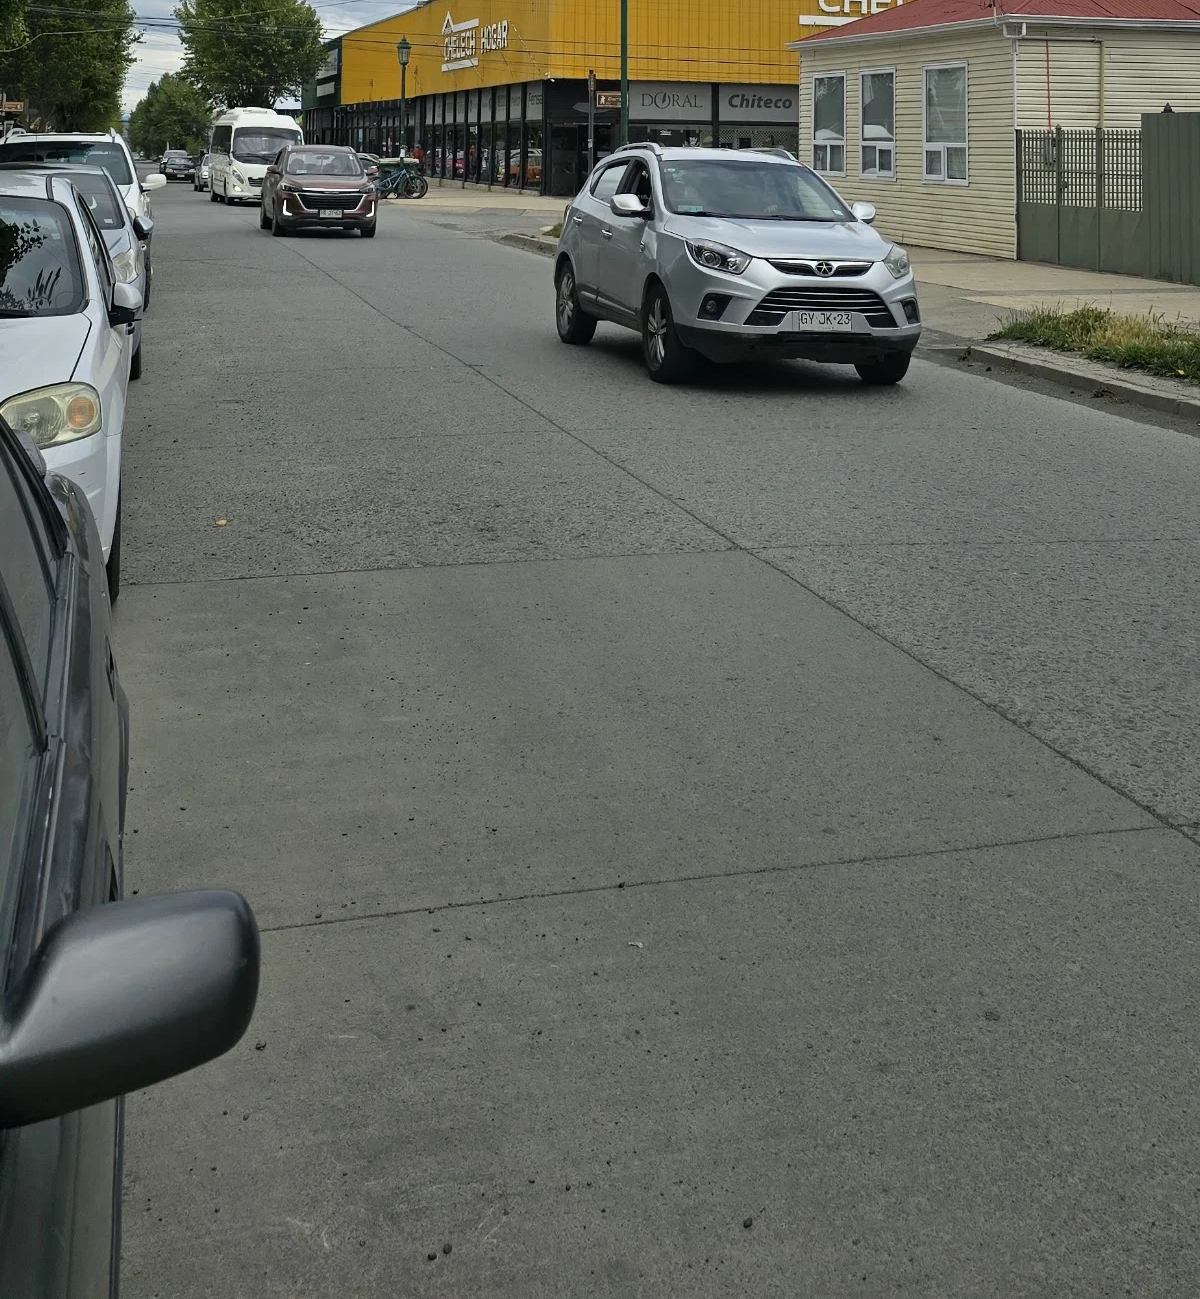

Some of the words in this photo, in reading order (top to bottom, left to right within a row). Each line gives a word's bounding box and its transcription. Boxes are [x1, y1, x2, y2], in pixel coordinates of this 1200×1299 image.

[443, 29, 476, 61] CHELECH
[480, 19, 508, 55] HOGAR
[641, 90, 703, 110] DORAL
[728, 93, 793, 110] Chiteco
